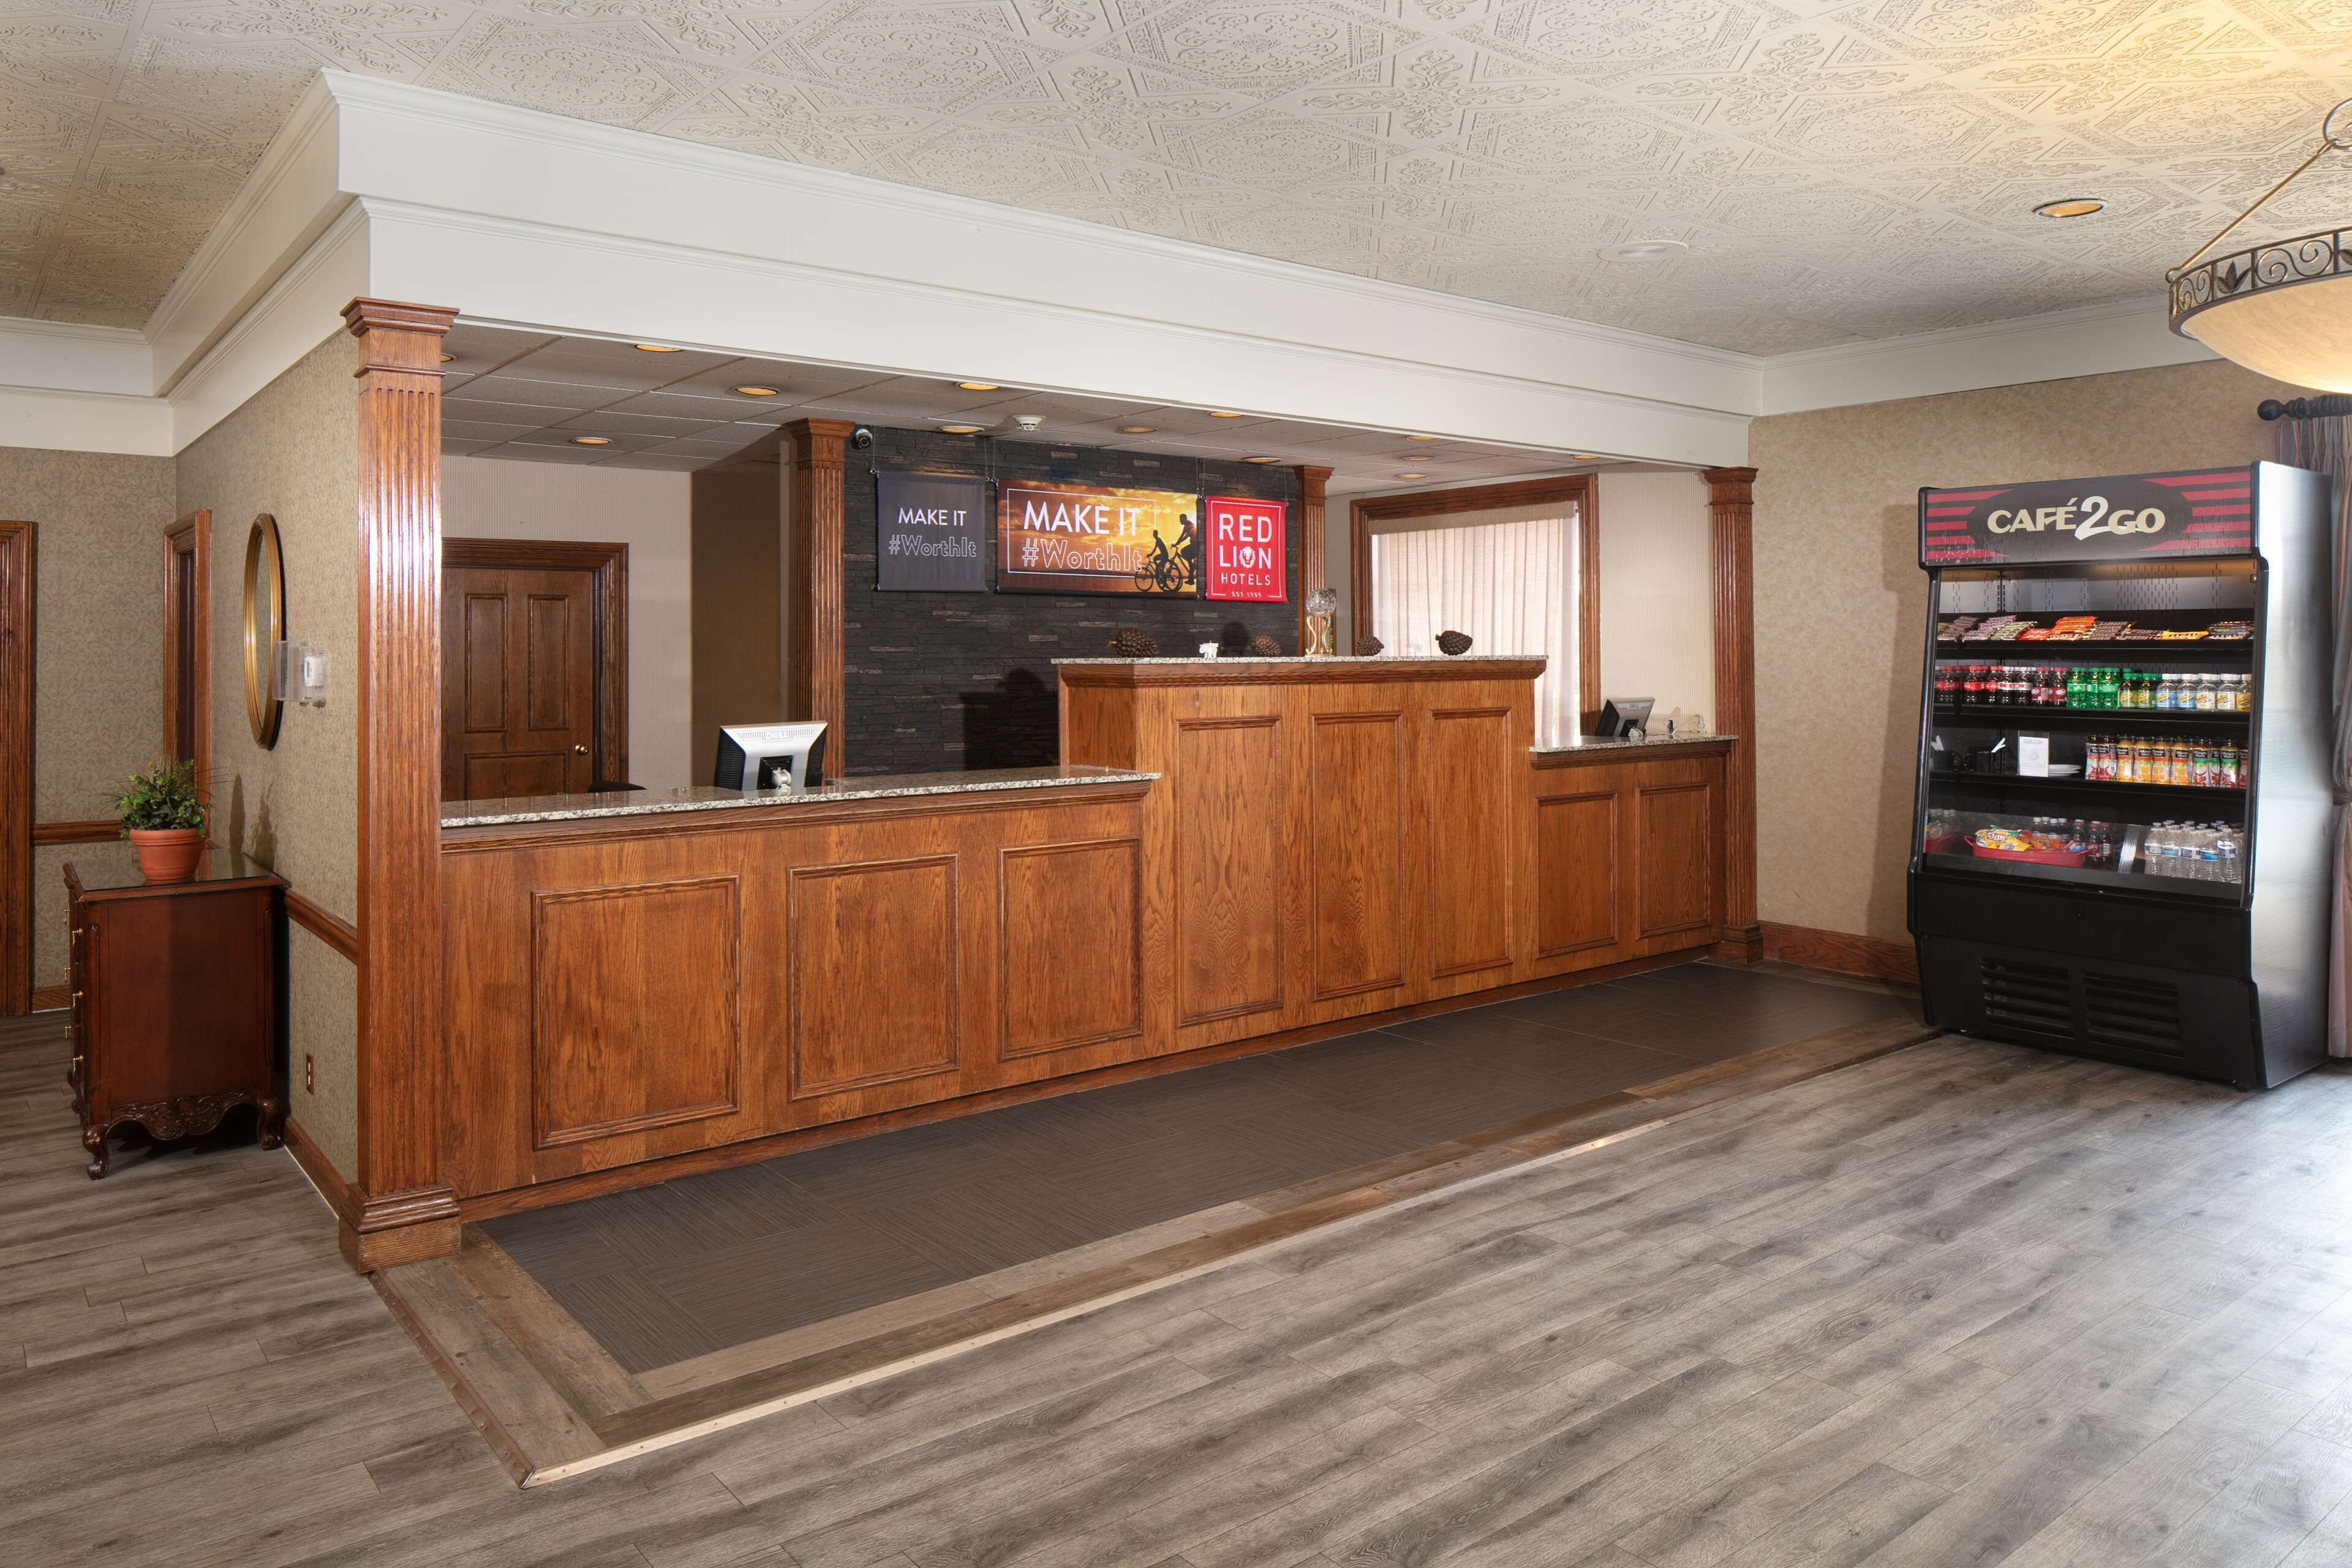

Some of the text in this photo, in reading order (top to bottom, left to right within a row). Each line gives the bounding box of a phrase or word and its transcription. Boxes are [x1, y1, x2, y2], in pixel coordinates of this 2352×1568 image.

[898, 507, 967, 526] MAKE IT
[1023, 500, 1140, 536] MAKE IT
[1219, 513, 1272, 543] RED
[888, 534, 977, 557] #WorthIt
[1022, 538, 1142, 572] #WorthIt
[1221, 573, 1271, 586] HOTELS
